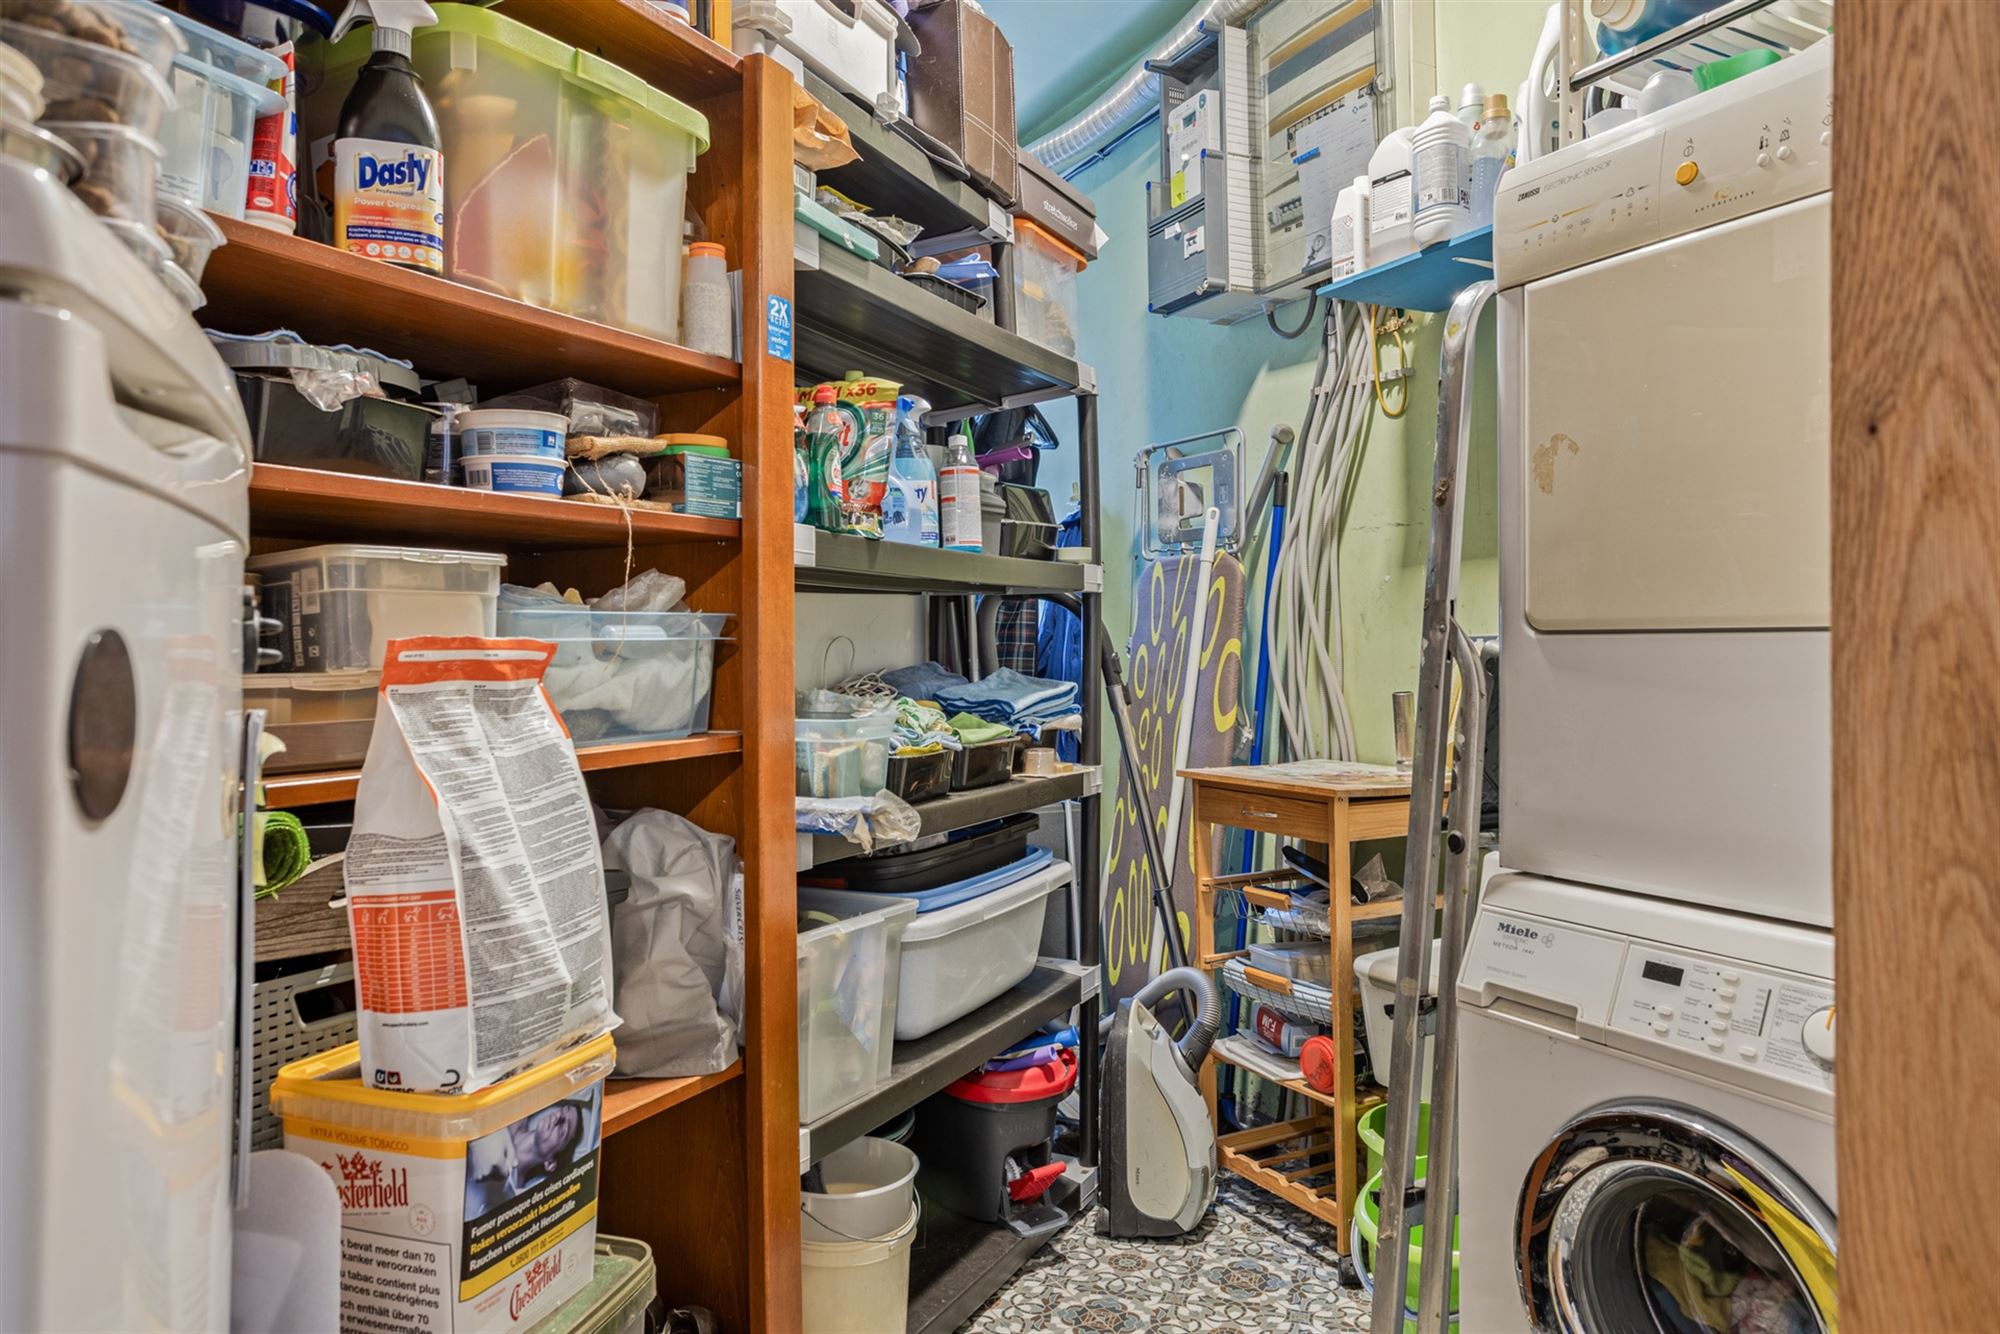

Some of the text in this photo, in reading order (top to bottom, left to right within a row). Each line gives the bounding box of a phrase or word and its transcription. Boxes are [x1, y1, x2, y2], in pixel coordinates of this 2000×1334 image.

[358, 152, 432, 191] Dasty
[354, 197, 385, 206] Power
[1517, 187, 1541, 202] ZANUSSI
[770, 299, 788, 321] 2X
[872, 412, 885, 421] 36
[1497, 922, 1539, 940] Miele
[1493, 940, 1518, 951] METEOR
[310, 1127, 409, 1151] EXTRA VOLUME TOBACCO
[471, 1219, 496, 1239] Fumer
[496, 1198, 531, 1227] provoque
[531, 1192, 544, 1205] des
[562, 1159, 594, 1186] cardiaques
[470, 1235, 496, 1255] Roken
[496, 1208, 538, 1240] veroorzaakt
[347, 1238, 372, 1252] bevat
[375, 1245, 400, 1258] meer
[402, 1249, 421, 1261] dan
[424, 1252, 436, 1264] 70
[469, 1246, 503, 1271] Rauchen
[503, 1222, 540, 1252] verursacht
[342, 1251, 437, 1277] kanker veroorzaken
[340, 1280, 439, 1309] tances cancérigènes
[347, 1269, 375, 1284] tabac
[376, 1276, 417, 1292] contient
[419, 1283, 441, 1296] plus
[510, 1248, 562, 1321] Chesterfield
[357, 1303, 390, 1318] enthält
[392, 1308, 415, 1322] über
[417, 1313, 430, 1325] 70
